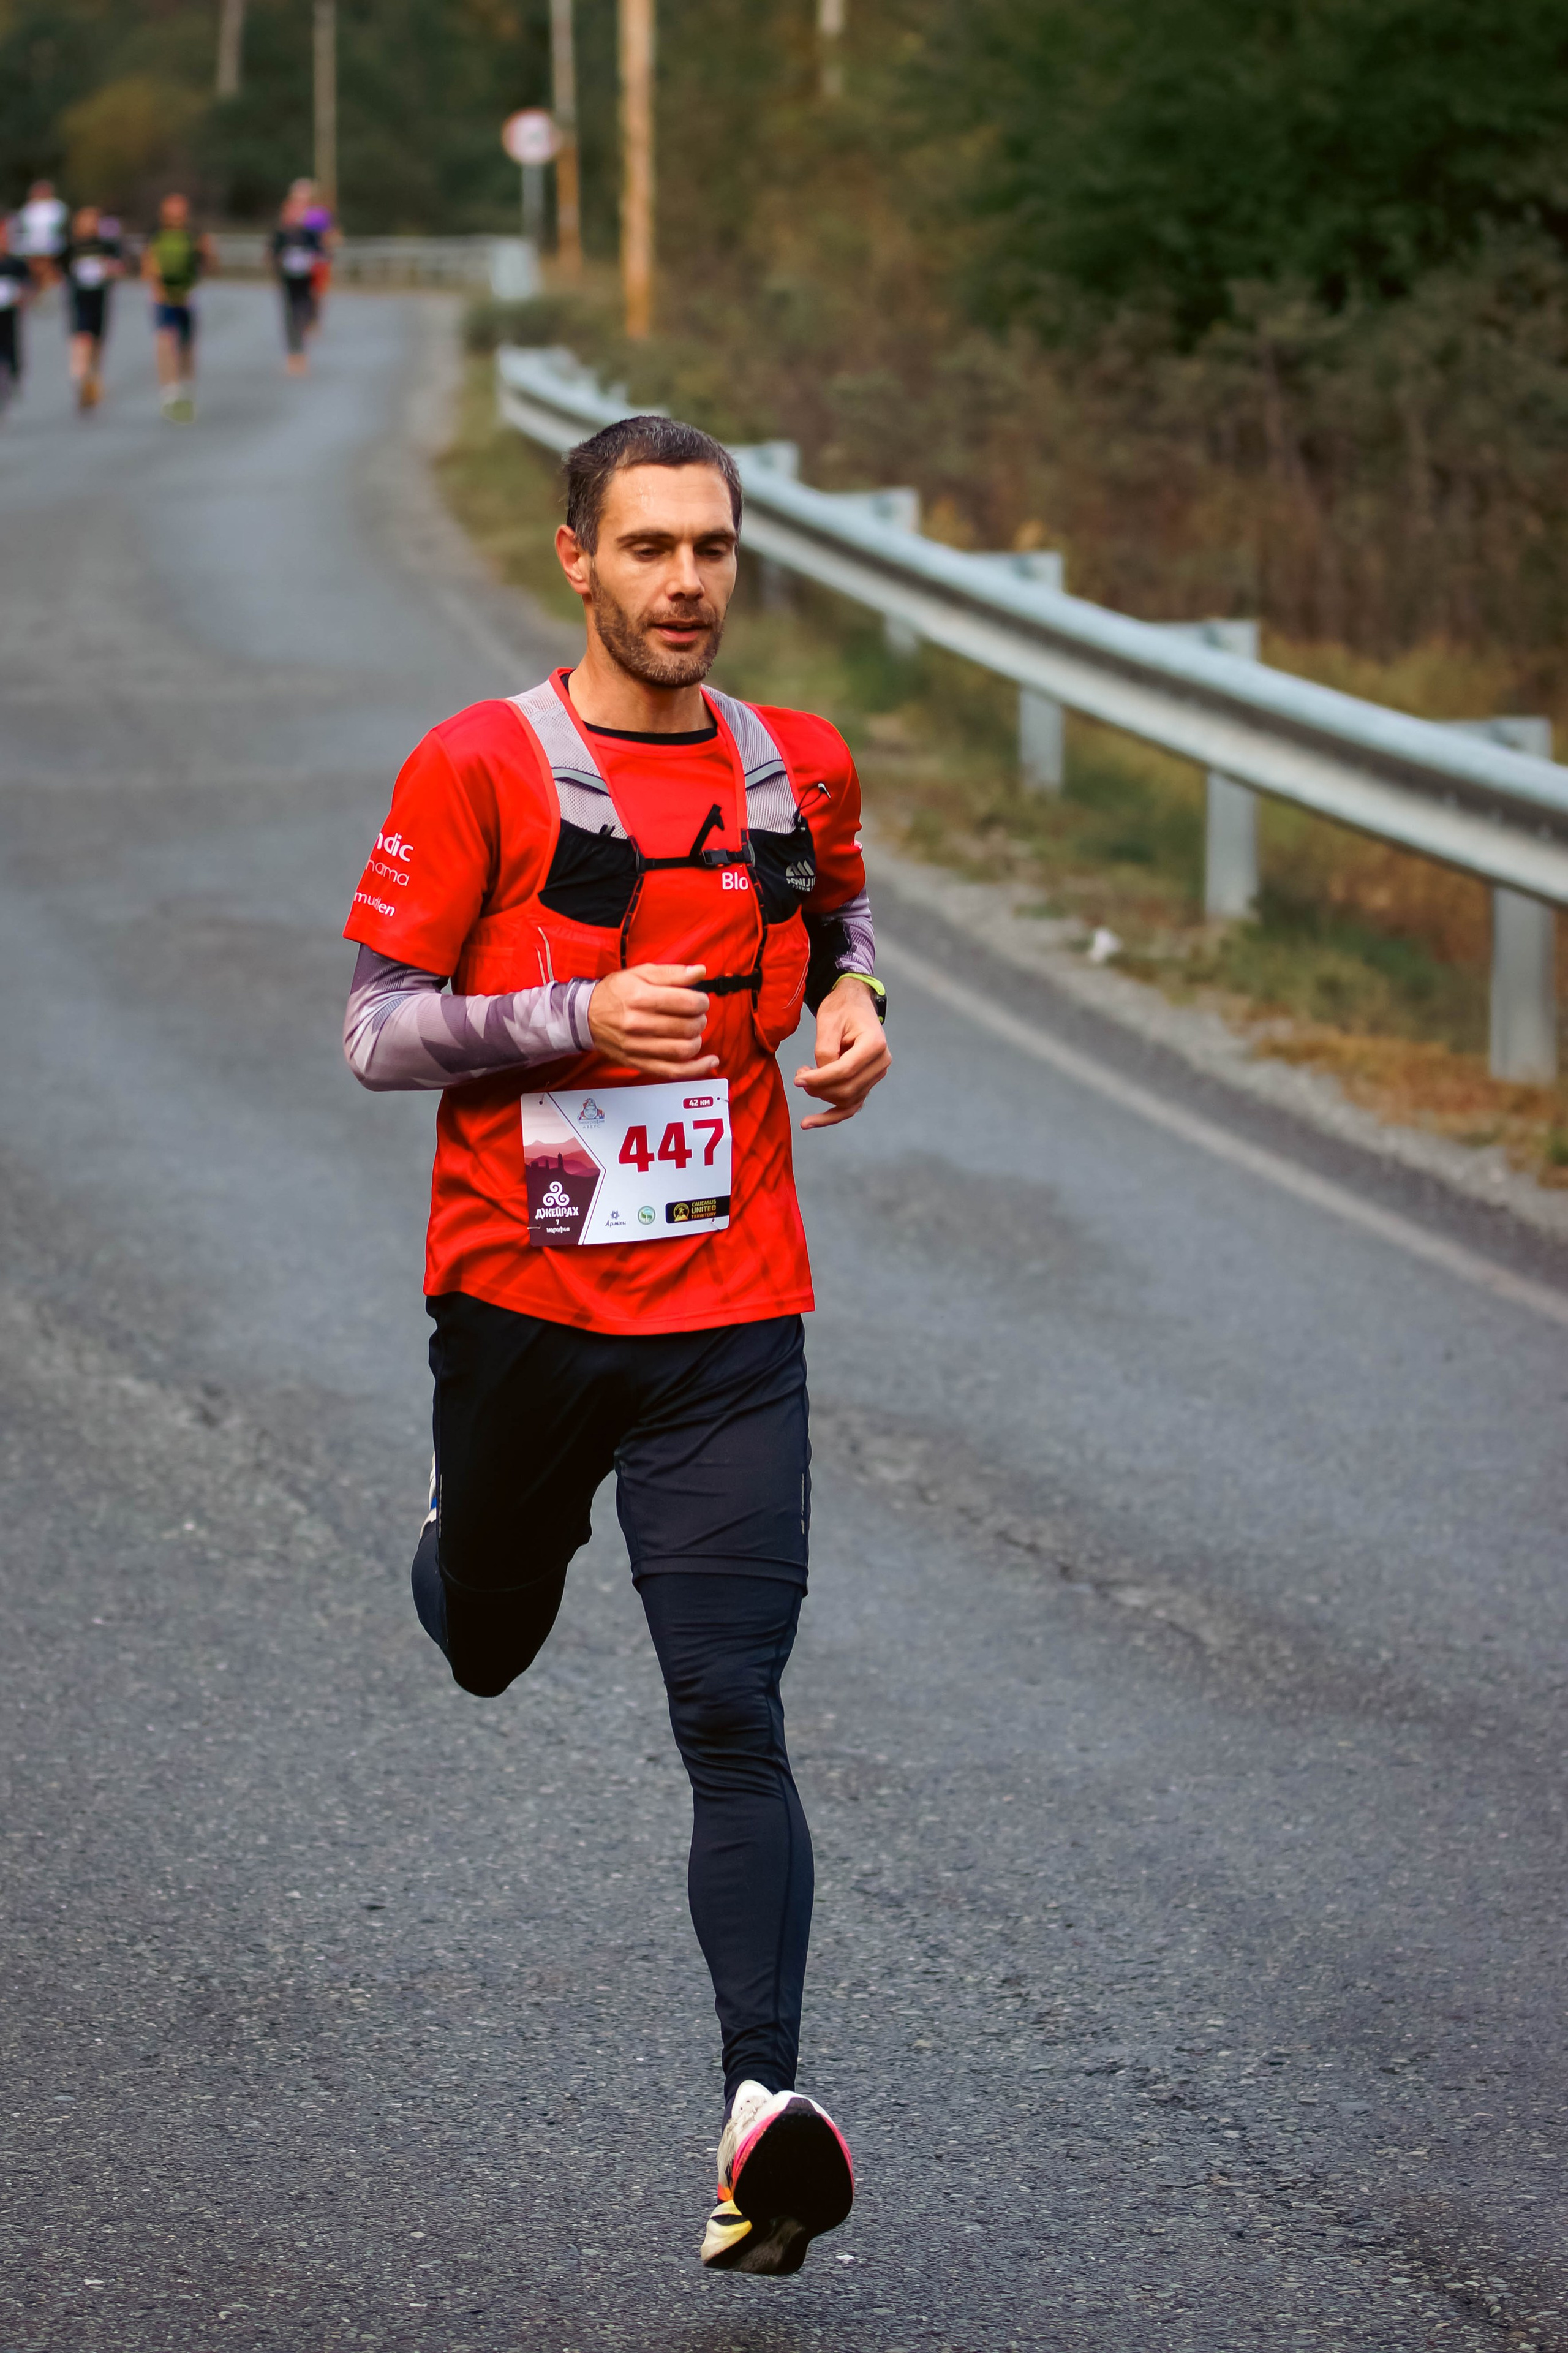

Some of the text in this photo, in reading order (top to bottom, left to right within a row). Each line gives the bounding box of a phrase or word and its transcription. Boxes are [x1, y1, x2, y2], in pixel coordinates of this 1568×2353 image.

[722, 871, 748, 891] Blo
[618, 1117, 725, 1173] 447
[535, 1206, 579, 1220] ДЖЕЙРАХ
[691, 1204, 717, 1214] UNITED
